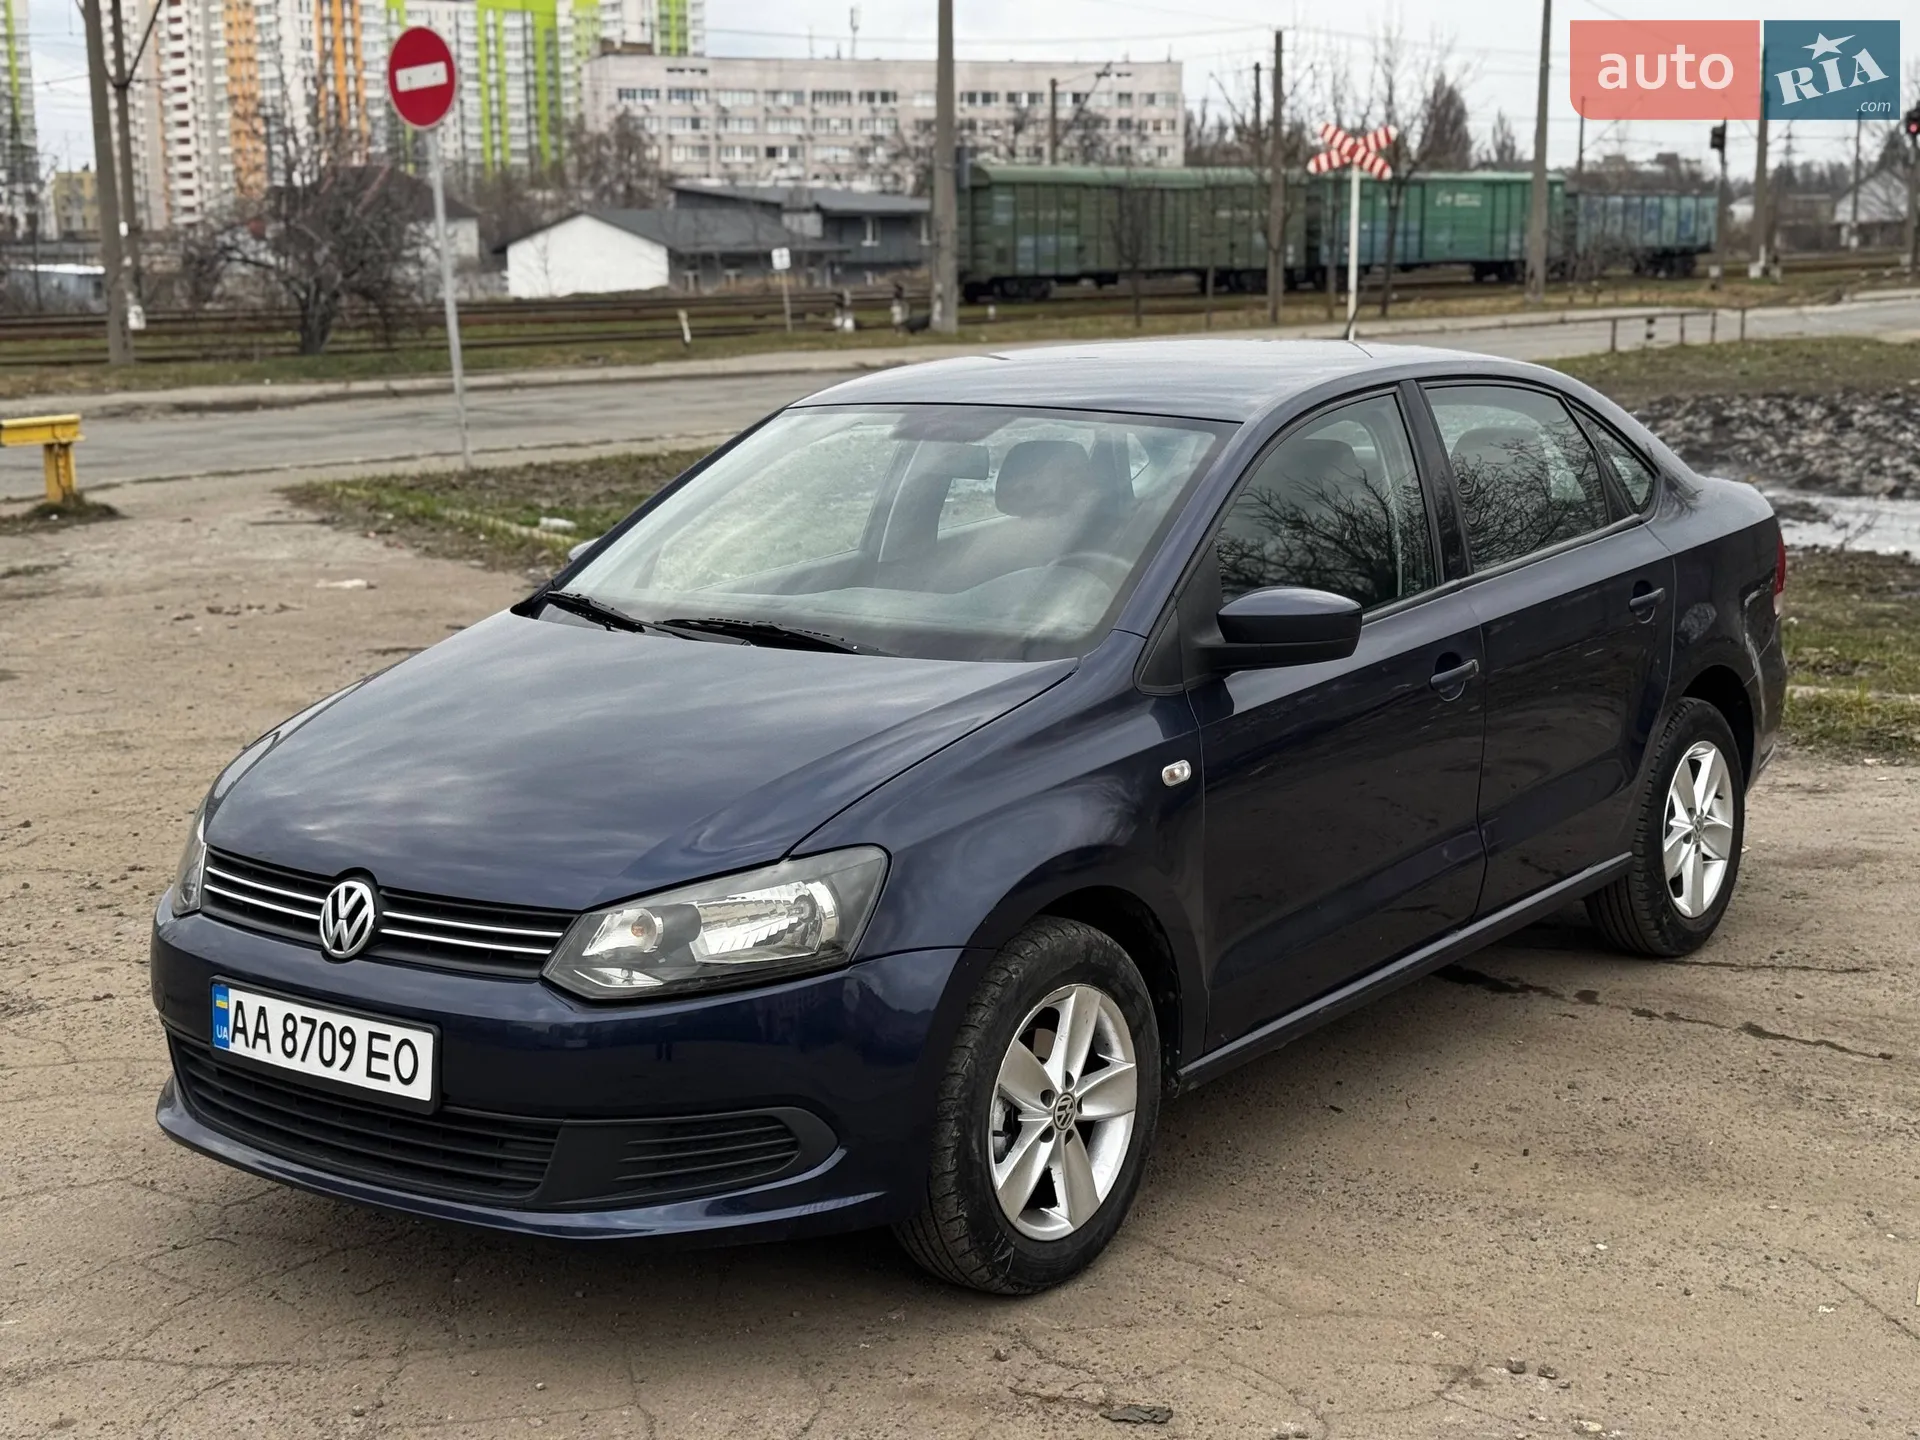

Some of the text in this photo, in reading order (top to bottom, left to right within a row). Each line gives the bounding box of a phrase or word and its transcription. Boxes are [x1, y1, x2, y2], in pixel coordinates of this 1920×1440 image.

[216, 1024, 229, 1041] UA
[230, 1000, 419, 1086] AA 8709 EO
